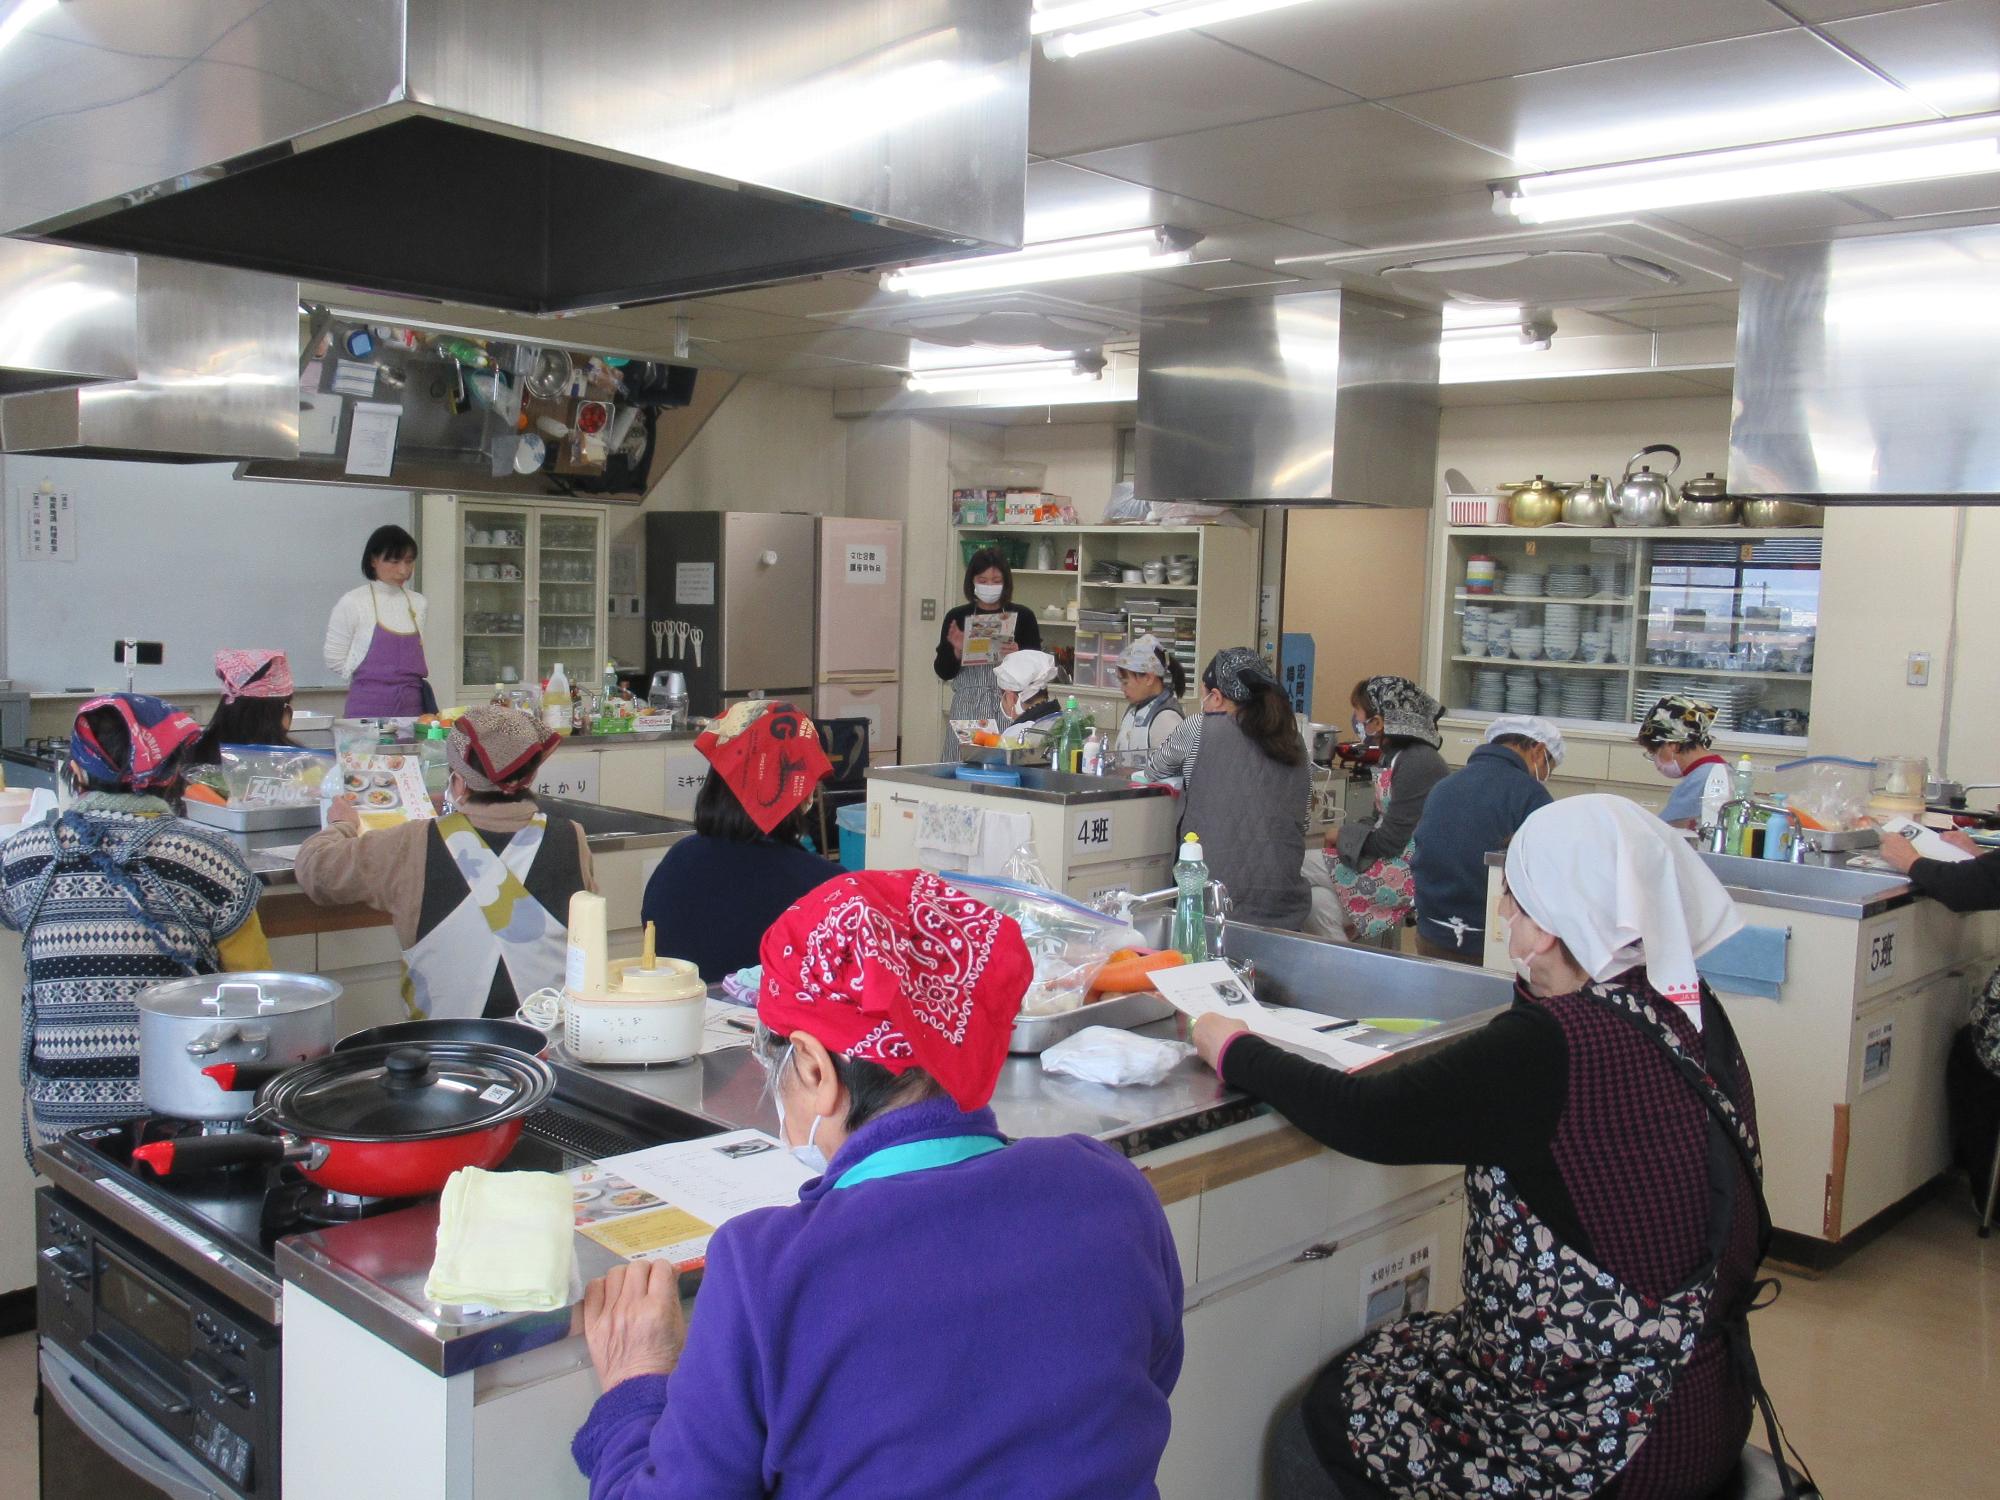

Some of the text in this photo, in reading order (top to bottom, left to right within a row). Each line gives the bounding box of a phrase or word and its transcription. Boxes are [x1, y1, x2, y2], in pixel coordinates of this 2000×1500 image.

[538, 780, 586, 795] はかり
[1078, 817, 1109, 845] 4班
[1870, 932, 1895, 972] 5班
